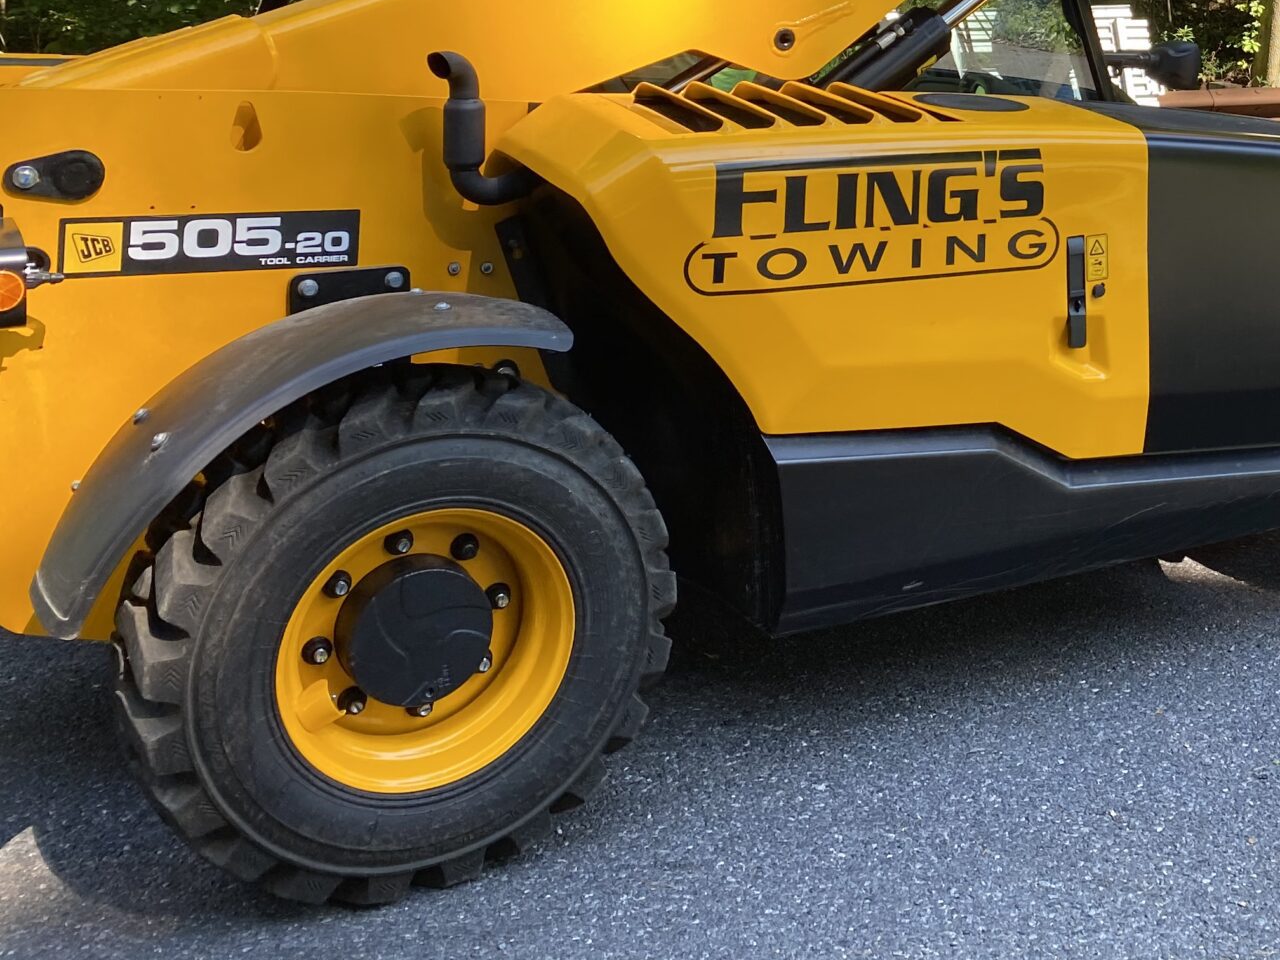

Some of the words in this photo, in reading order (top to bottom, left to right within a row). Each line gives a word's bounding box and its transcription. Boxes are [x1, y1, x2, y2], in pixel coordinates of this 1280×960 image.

[711, 148, 1045, 239] FLING'S
[79, 236, 112, 258] JCB
[128, 217, 350, 261] 505-20
[259, 257, 291, 266] TOOL
[296, 254, 349, 264] CARRIER
[701, 229, 1048, 284] TOWING
